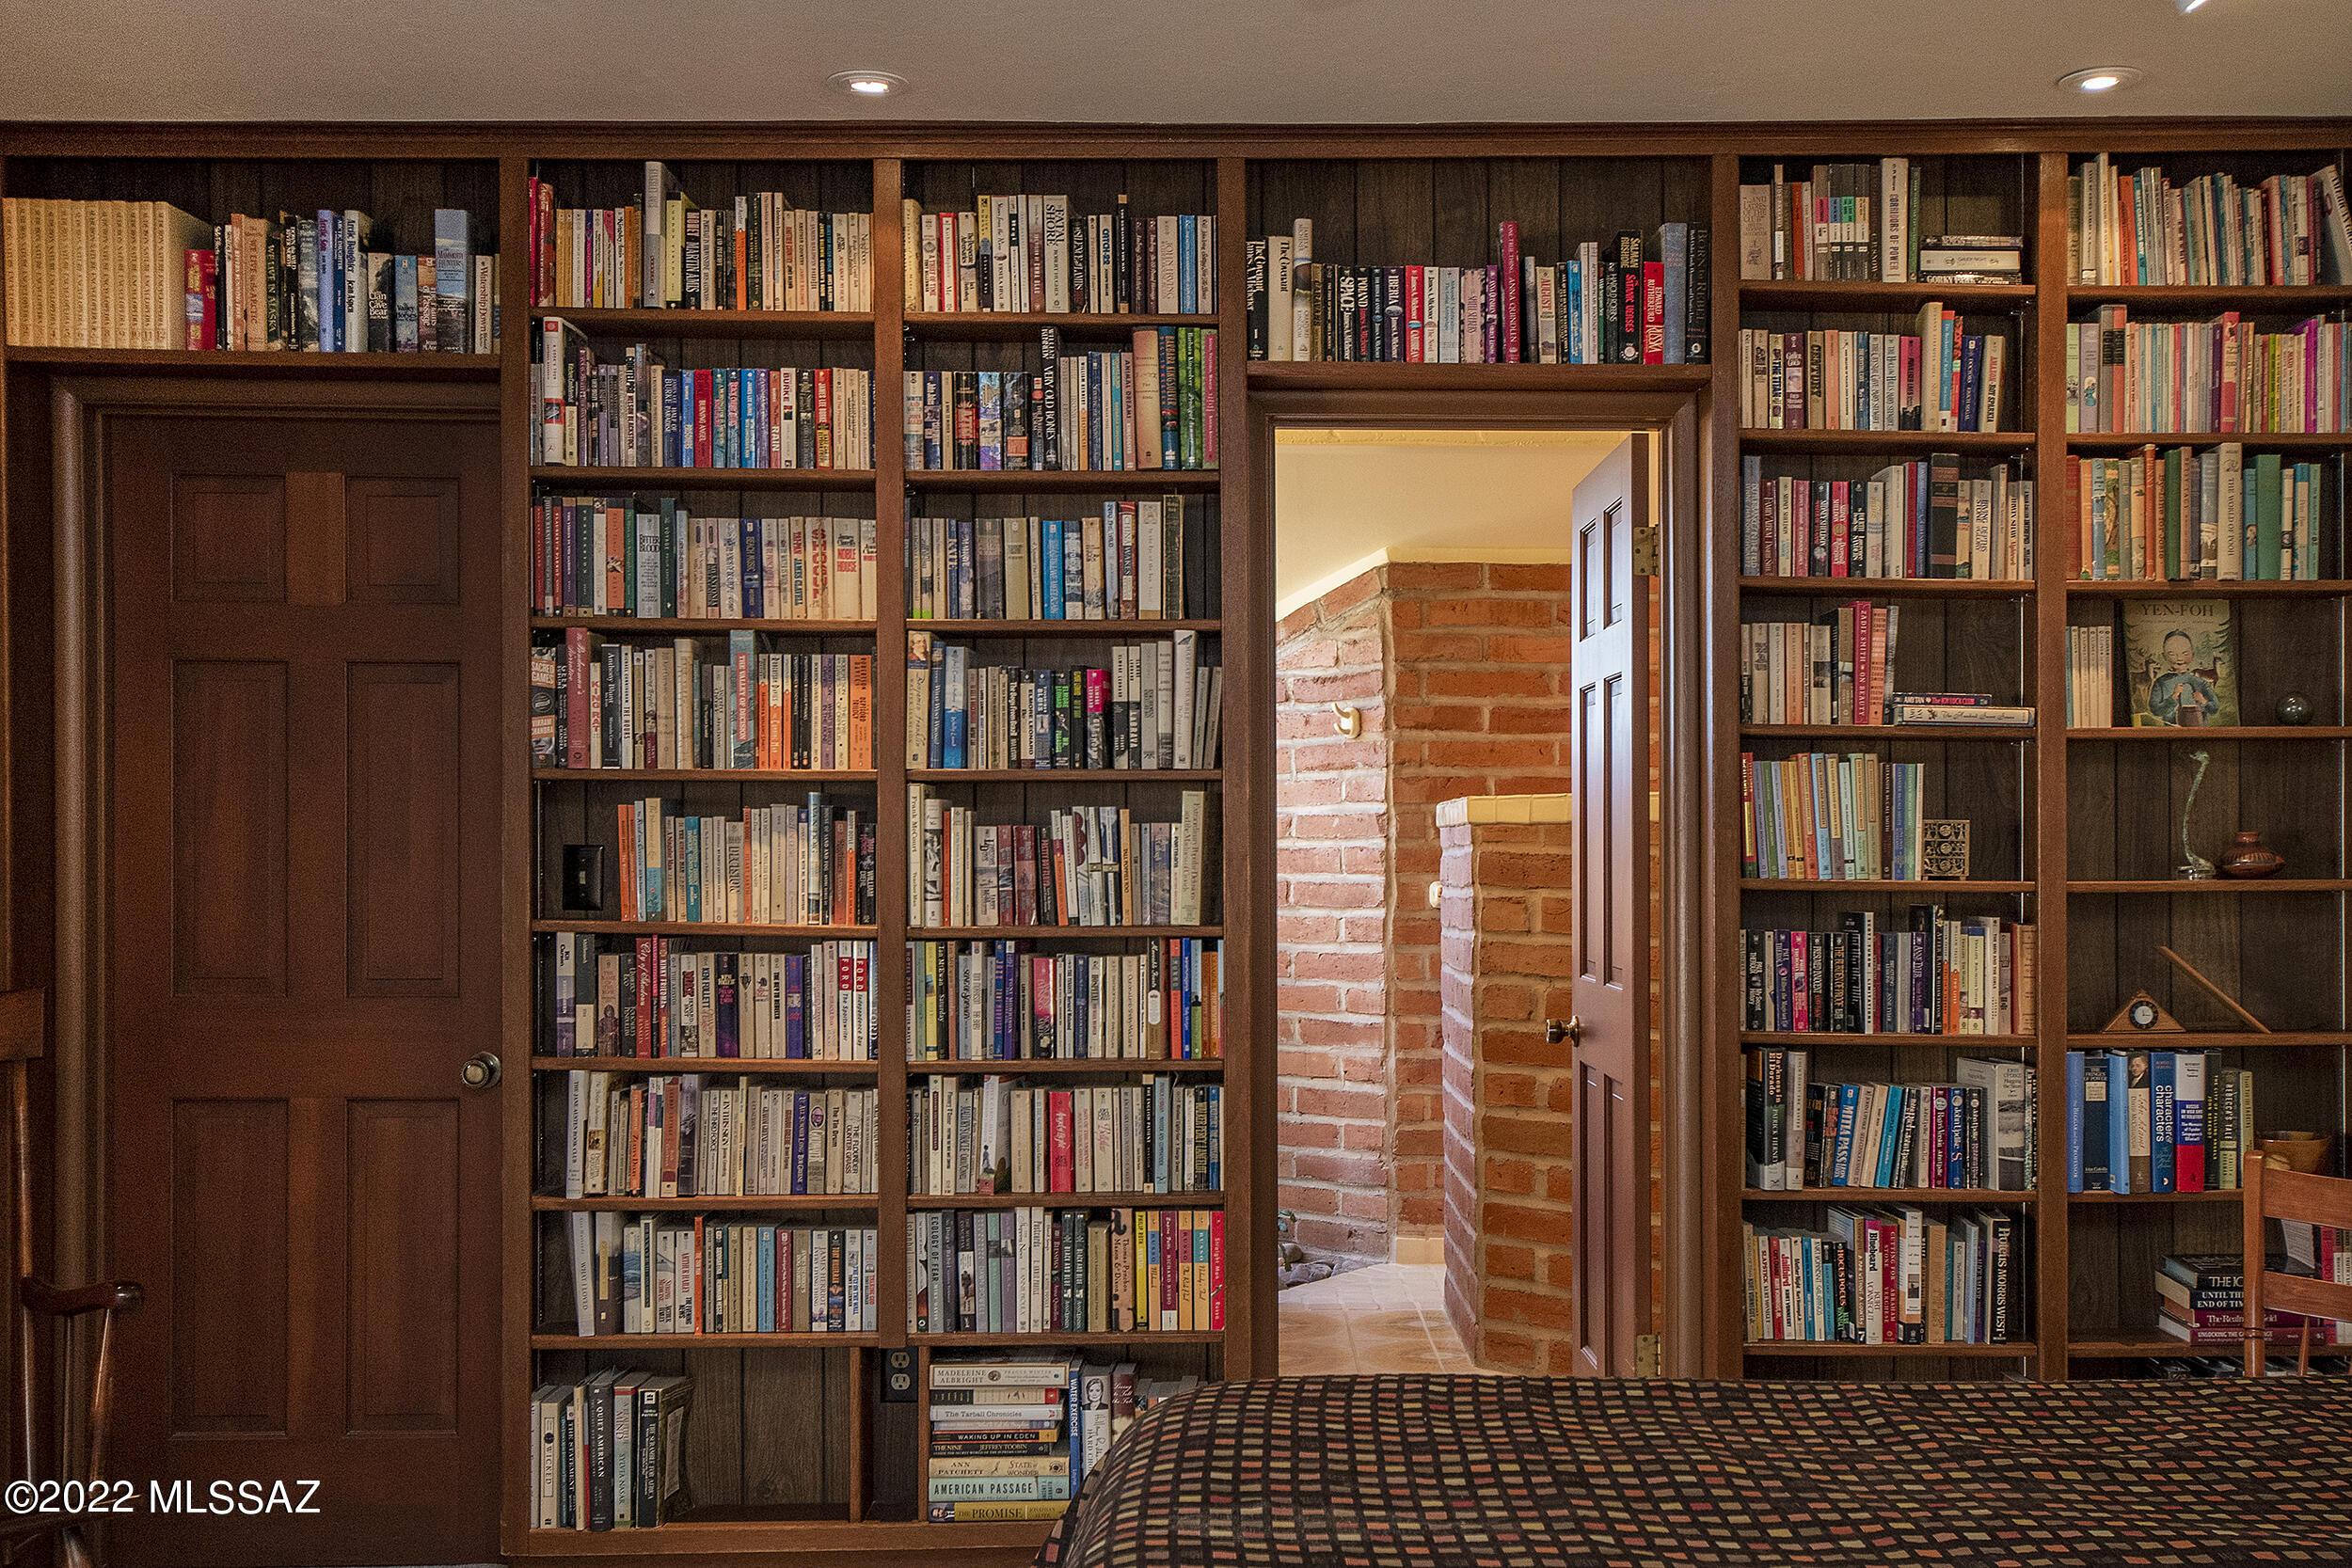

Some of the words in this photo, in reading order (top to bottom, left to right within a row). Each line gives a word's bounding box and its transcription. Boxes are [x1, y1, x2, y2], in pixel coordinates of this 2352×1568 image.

[687, 212, 699, 238] MONEY
[1046, 204, 1056, 245] SHORE
[1889, 194, 1899, 233] CORRIDORS
[346, 219, 356, 238] Arctic
[1055, 208, 1064, 246] FATAL
[1889, 235, 1899, 245] OF
[266, 245, 275, 259] WE
[345, 240, 357, 272] Daughter
[685, 241, 700, 271] MARTIN
[1102, 229, 1110, 265] CATCH-22
[1620, 236, 1629, 268] RUSHDIE
[1629, 237, 1639, 268] SALMAN
[1889, 246, 1899, 270] POWER
[267, 285, 275, 295] IN
[345, 279, 356, 293] Jean
[478, 266, 489, 308] Watership
[685, 273, 699, 293] AMIS
[1340, 276, 1354, 311] SPACE
[1388, 275, 1398, 305] IBERIA
[1540, 277, 1551, 309] AUGUST
[1625, 274, 1636, 303] SATANIC
[345, 293, 356, 313] Aspen
[422, 297, 431, 326] Passage
[1647, 278, 1656, 322] RUTHERFURD
[267, 299, 277, 332] ALASKA
[480, 309, 488, 331] Down
[1625, 305, 1635, 333] VERSES
[1044, 365, 1054, 388] VERY
[698, 400, 707, 423] BURNING
[1044, 389, 1055, 408] OLD
[1124, 389, 1133, 419] DREAMS
[698, 424, 707, 442] ANGEL
[1045, 410, 1056, 440] BONES
[771, 426, 780, 451] RAIN
[640, 534, 660, 544] BITTER
[2228, 523, 2234, 532] OF
[640, 544, 660, 552] BLOOD
[836, 548, 856, 560] NOBLE
[836, 562, 857, 572] HOUSE
[2141, 604, 2214, 617] YEN-FOH
[532, 661, 554, 673] SACRED
[532, 672, 553, 685] GAMES
[606, 653, 616, 682] Anthony
[591, 681, 600, 708] KING
[608, 683, 616, 704] Blunt
[739, 669, 747, 694] VALLEY
[739, 695, 747, 707] OF
[592, 712, 600, 732] RAT
[623, 718, 631, 739] HOURS
[739, 707, 748, 740] DECISION
[911, 822, 919, 853] McCourt
[866, 870, 875, 897] WILLIAM
[639, 942, 651, 959] City
[638, 961, 650, 970] of
[701, 967, 709, 981] KEN
[841, 958, 850, 990] FORD
[639, 971, 649, 1006] Shadows
[702, 981, 710, 1009] FOLLETT
[856, 994, 865, 1034] Independence
[1769, 1053, 1775, 1062] El
[2155, 1085, 2165, 1142] characters
[2224, 1084, 2233, 1121] REBECCA'S
[2223, 1124, 2233, 1140] TALE
[930, 1216, 939, 1249] ECOLOGY
[1033, 1220, 1041, 1247] Postcards
[931, 1252, 939, 1262] OF
[1868, 1232, 1879, 1272] Bluebeard
[1997, 1227, 2010, 1267] Proteus
[1114, 1261, 1121, 1272] &
[1996, 1268, 2006, 1305] MORRIS
[2208, 1276, 2231, 1287] THE
[1995, 1307, 2005, 1334] WEST
[1071, 1403, 1079, 1437] EXERCISE
[934, 1483, 984, 1496] AMERICAN
[991, 1482, 1032, 1494] PASSAGE
[972, 1508, 1023, 1519] PROMISE
